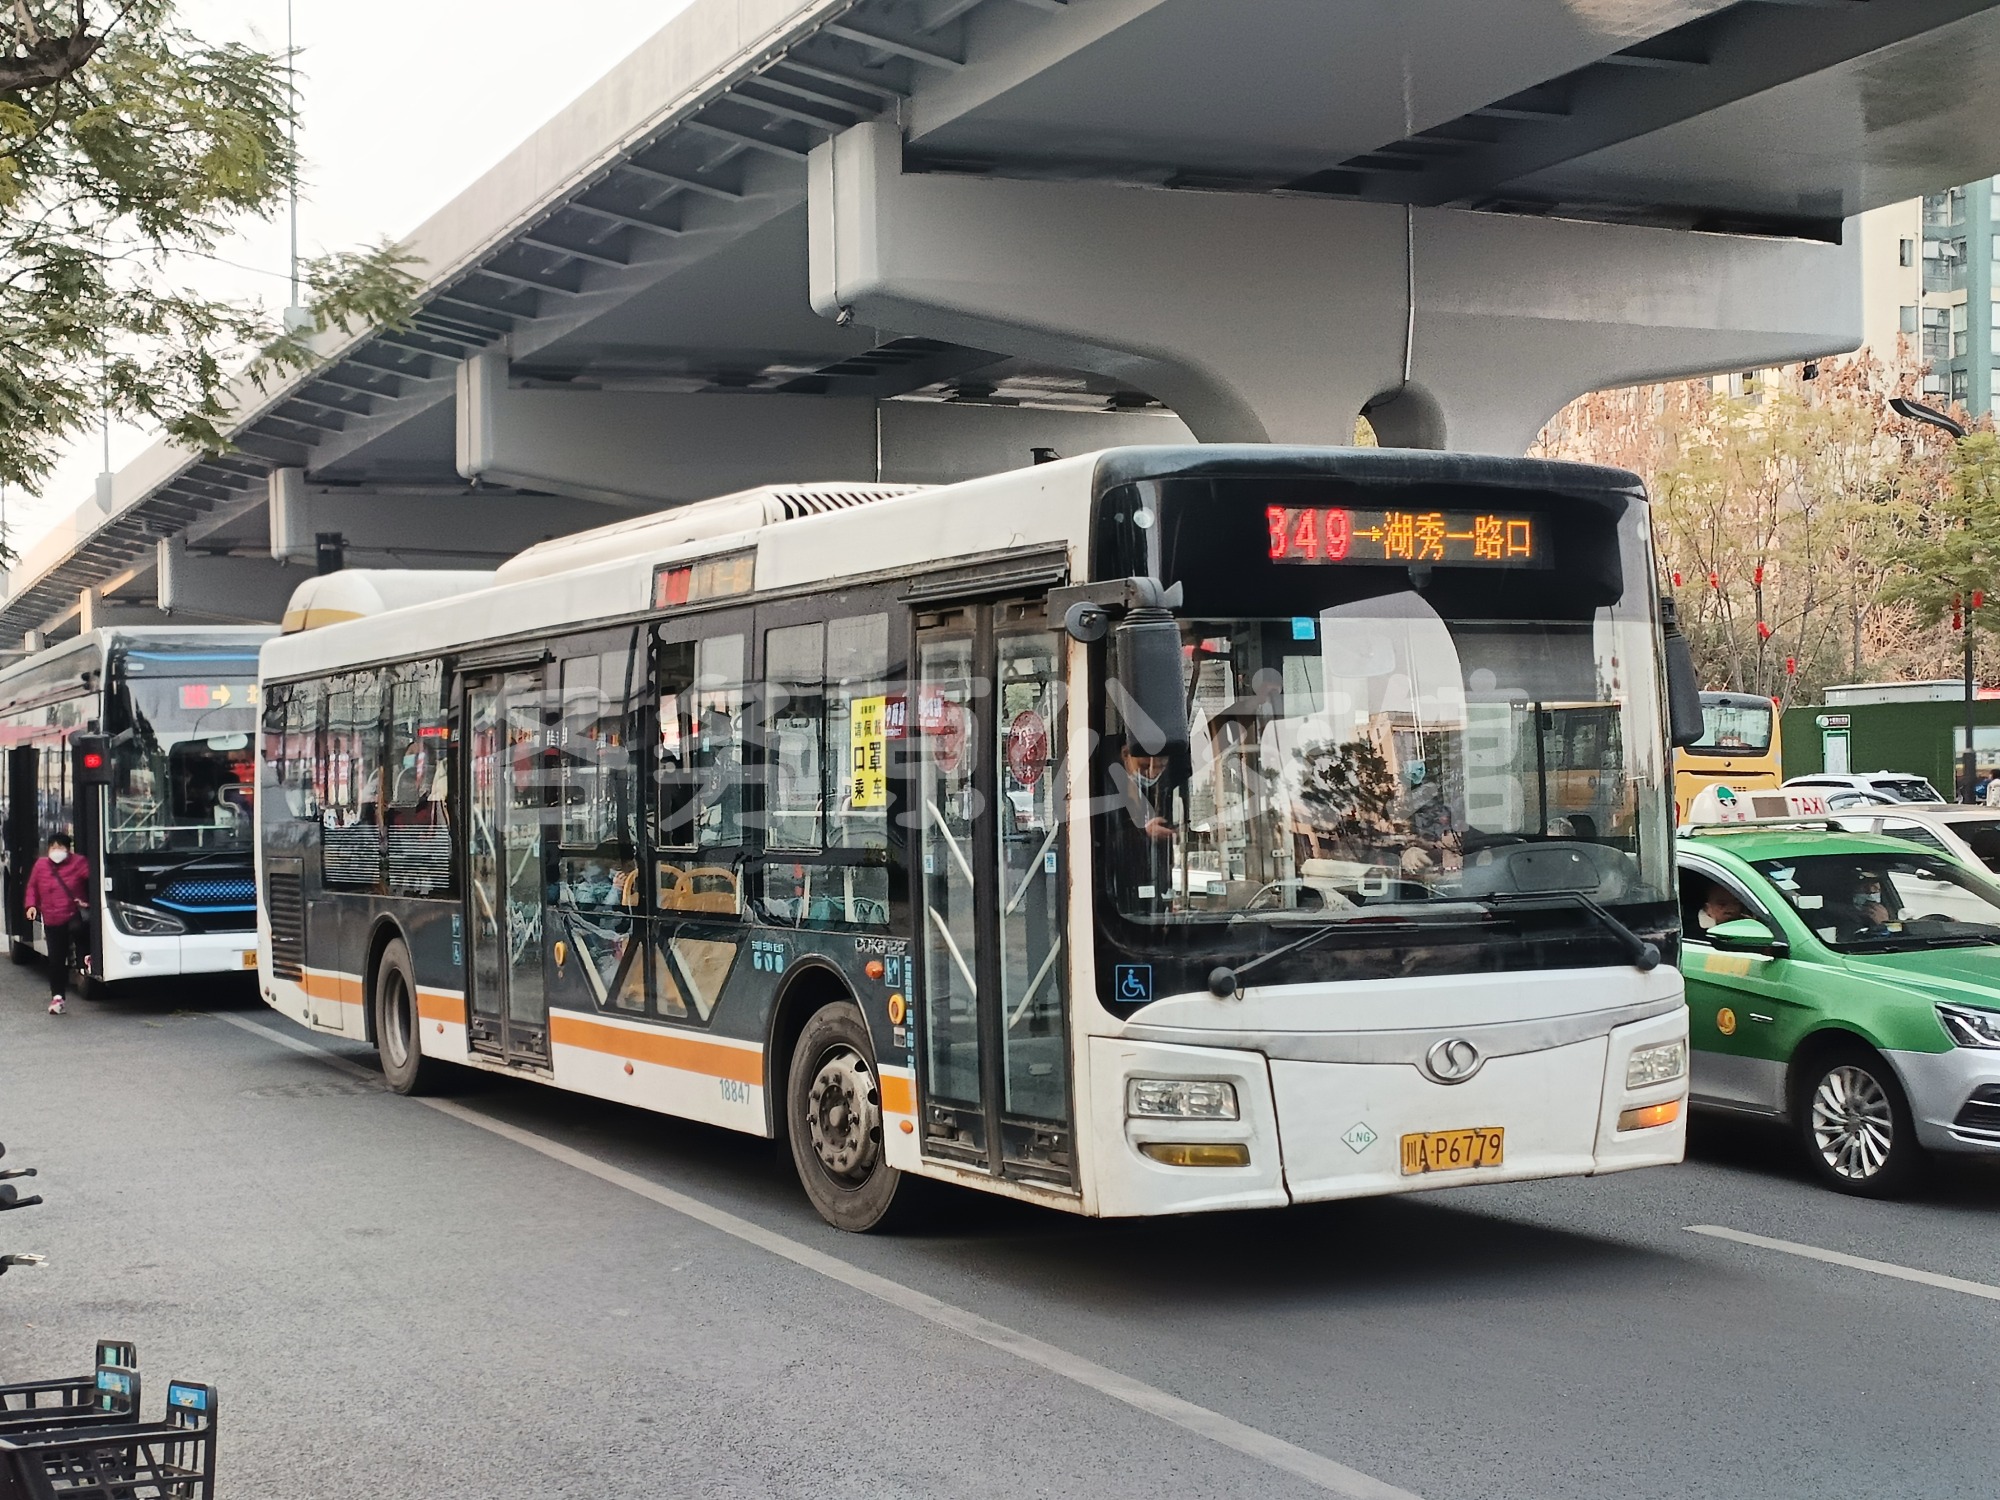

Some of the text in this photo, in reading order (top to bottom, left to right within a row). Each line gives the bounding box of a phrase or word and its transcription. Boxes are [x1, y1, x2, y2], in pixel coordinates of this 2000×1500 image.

[1382, 511, 1531, 561] 湖秀一路口
[854, 718, 882, 738] 请佩戴
[854, 741, 882, 773] 口罩
[854, 777, 882, 800] 乘车
[1791, 797, 1826, 816] TAXI
[719, 1078, 750, 1105] 18847
[1348, 1131, 1371, 1143] LNG
